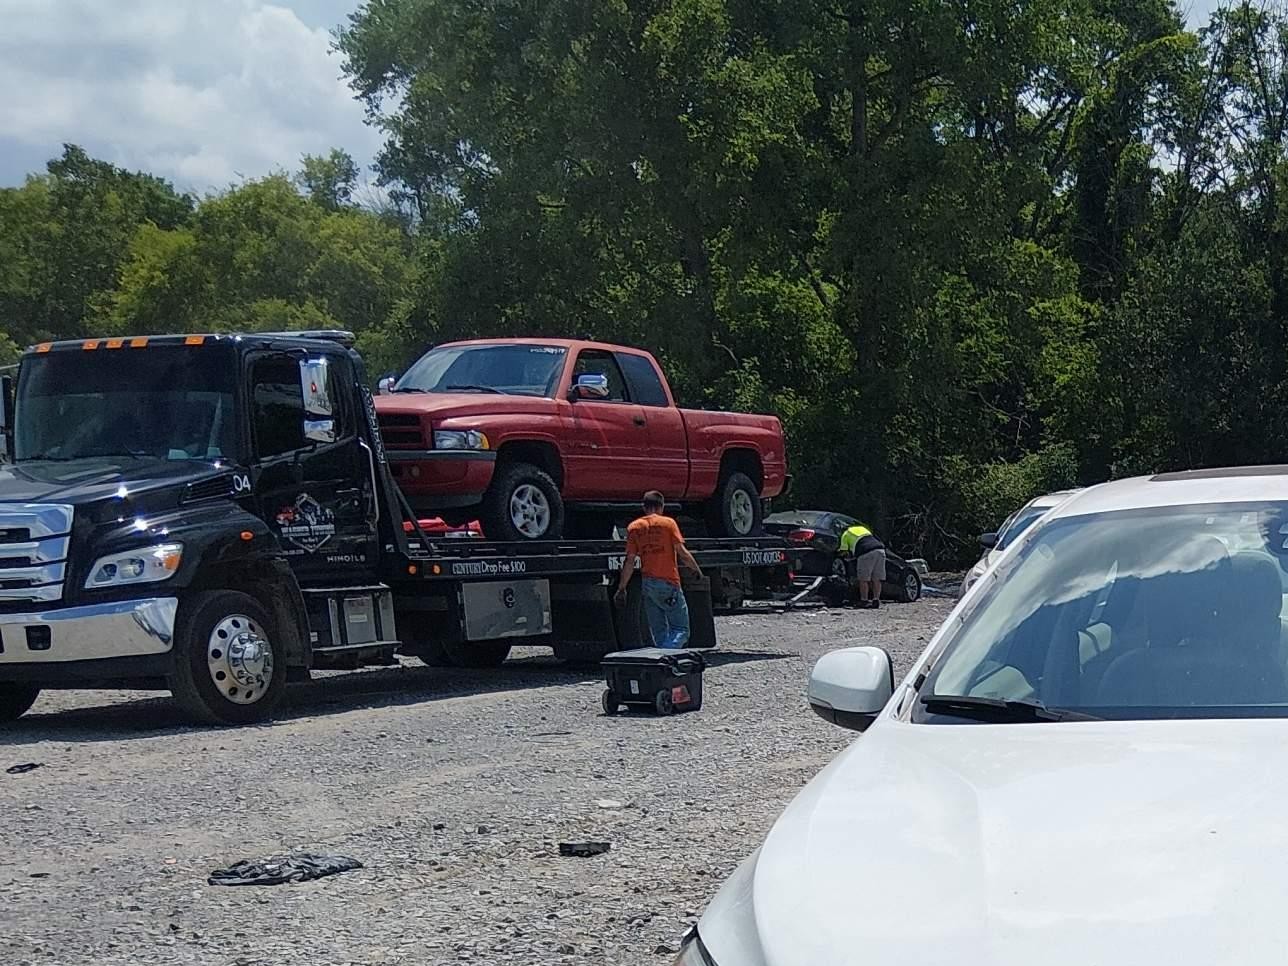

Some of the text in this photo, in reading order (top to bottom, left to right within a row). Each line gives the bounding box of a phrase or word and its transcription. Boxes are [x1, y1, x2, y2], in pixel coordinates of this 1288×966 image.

[233, 475, 251, 491] 04
[481, 561, 498, 576] Drop
[498, 561, 510, 573] Fee
